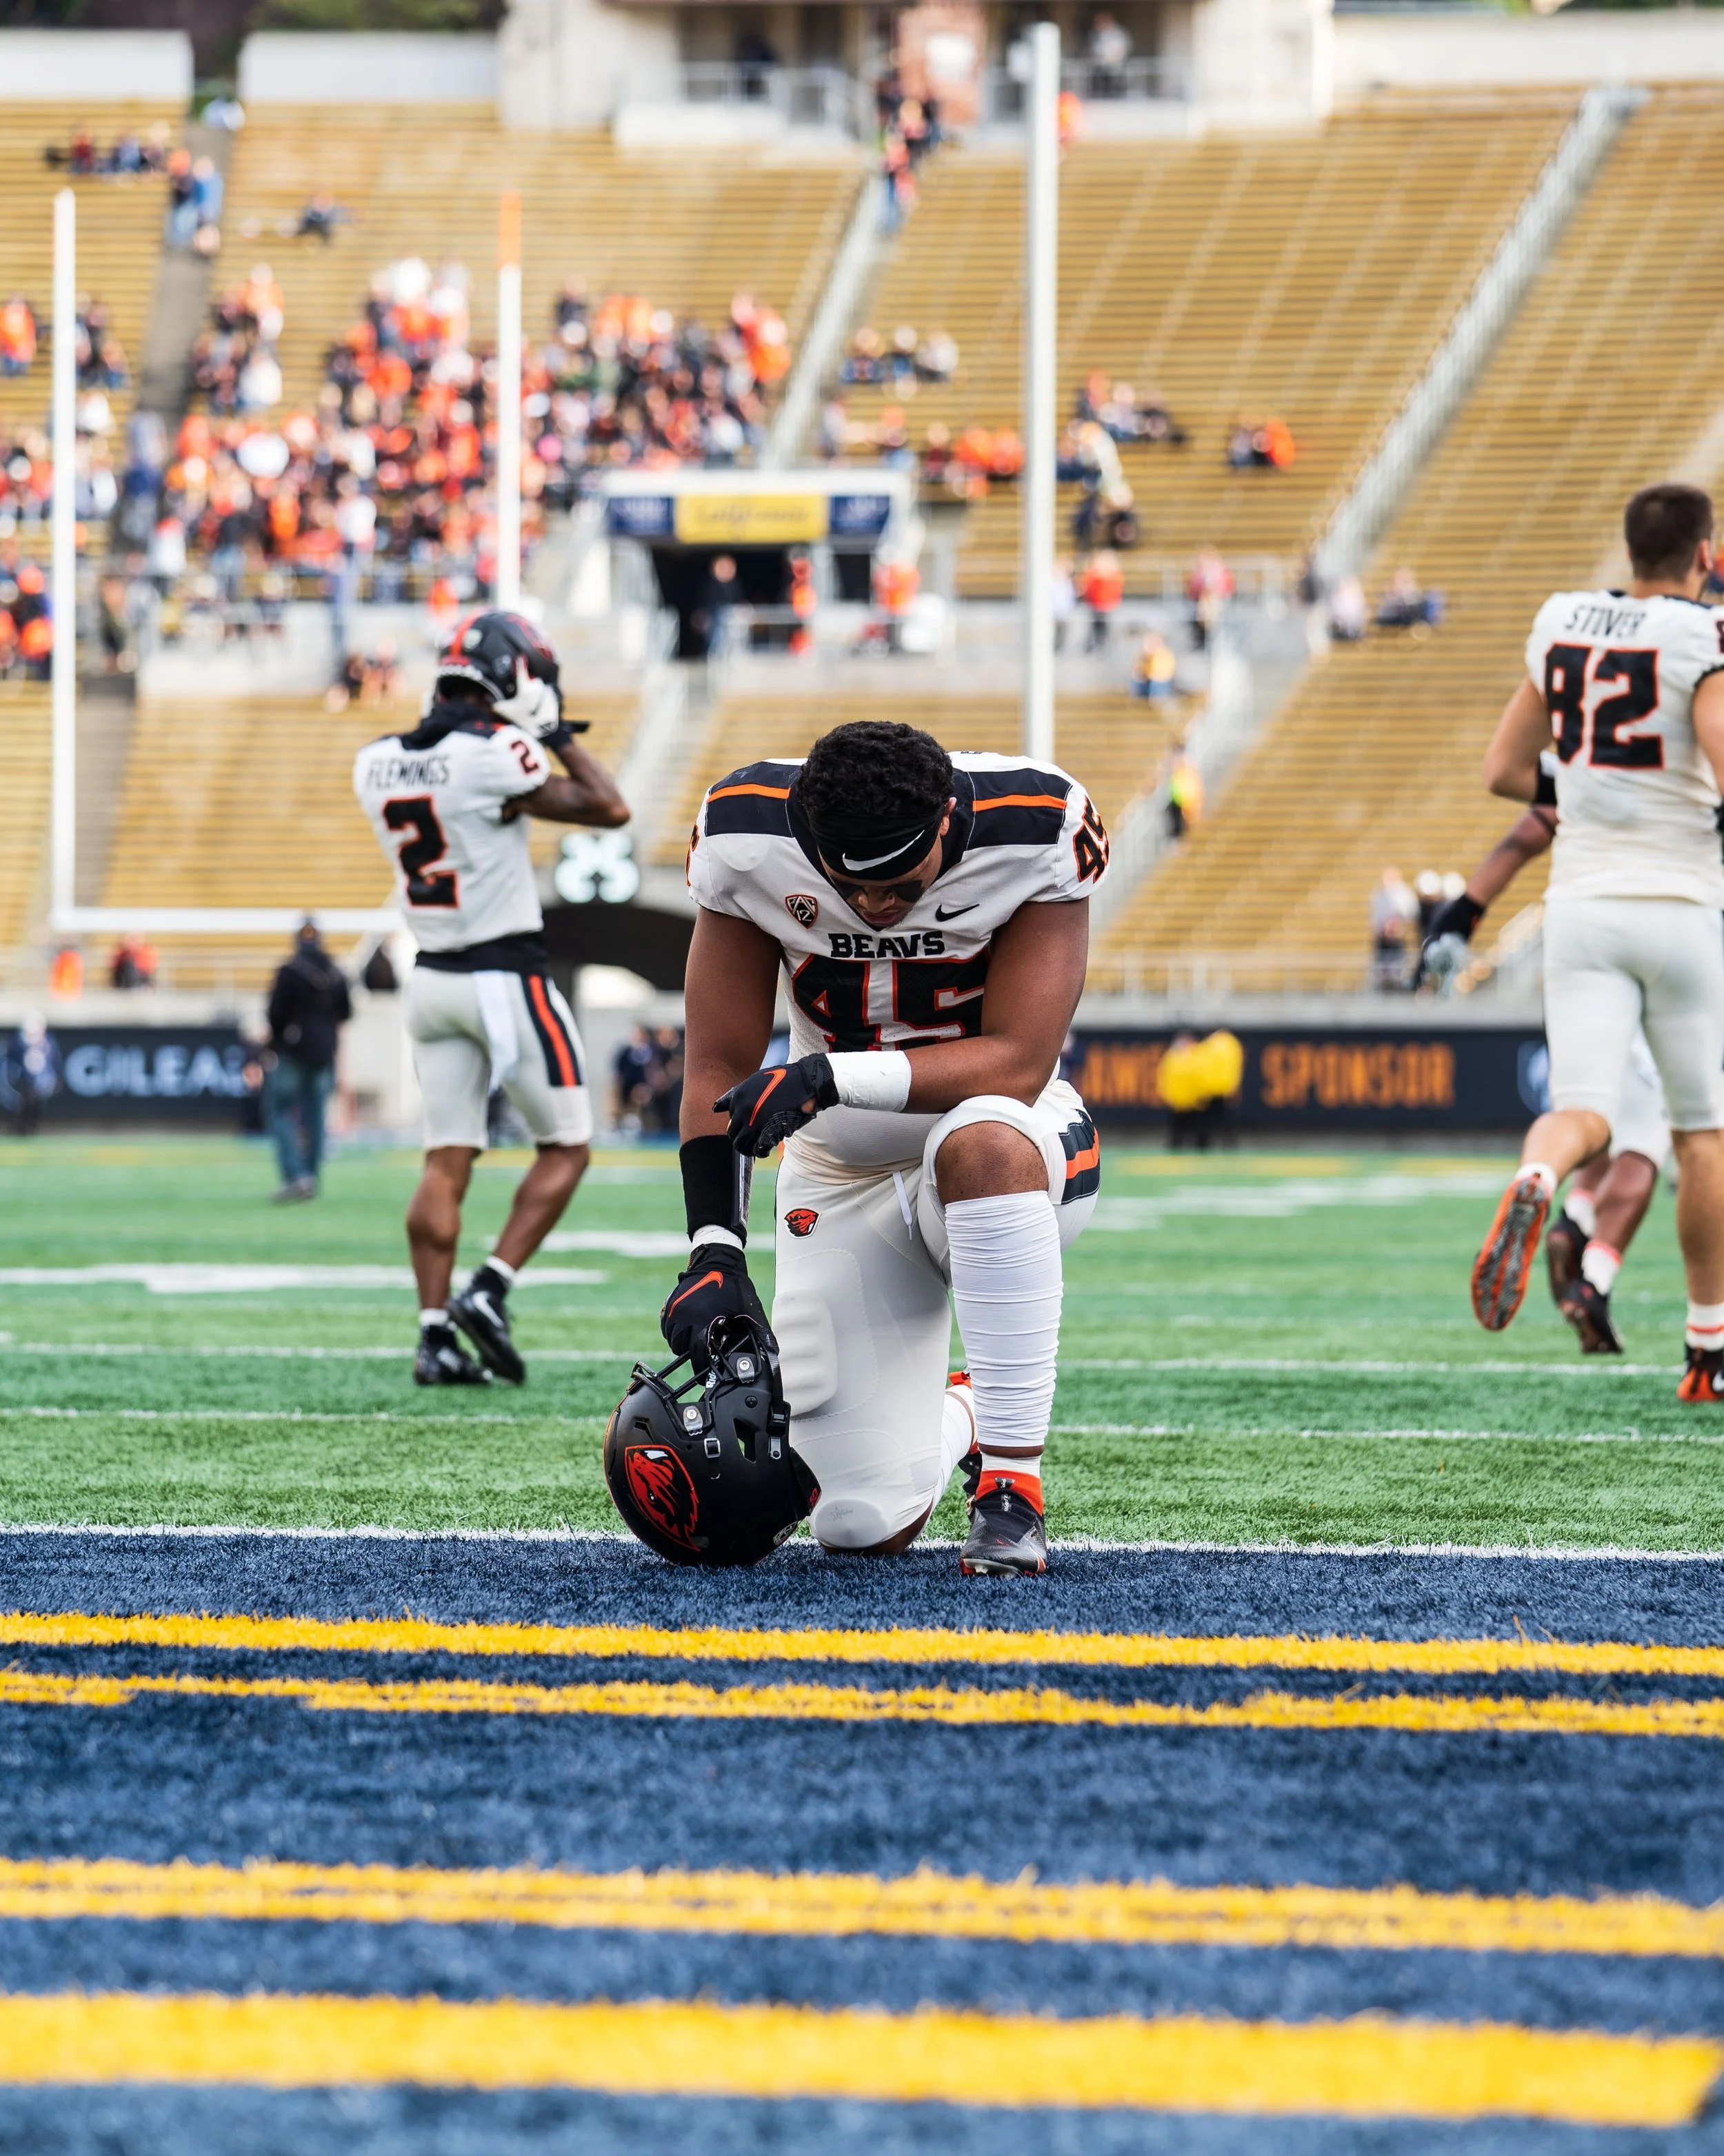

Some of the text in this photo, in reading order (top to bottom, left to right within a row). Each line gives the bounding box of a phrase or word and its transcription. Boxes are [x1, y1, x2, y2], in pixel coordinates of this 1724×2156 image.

[1544, 642, 1665, 769] 82
[365, 755, 450, 789] FLEMINGS
[510, 739, 540, 775] 2
[381, 792, 461, 909] 2
[796, 909, 812, 923] 12
[828, 930, 945, 959] BEAVS
[792, 947, 990, 1054] 45
[1260, 1042, 1456, 1109] SPONSOR
